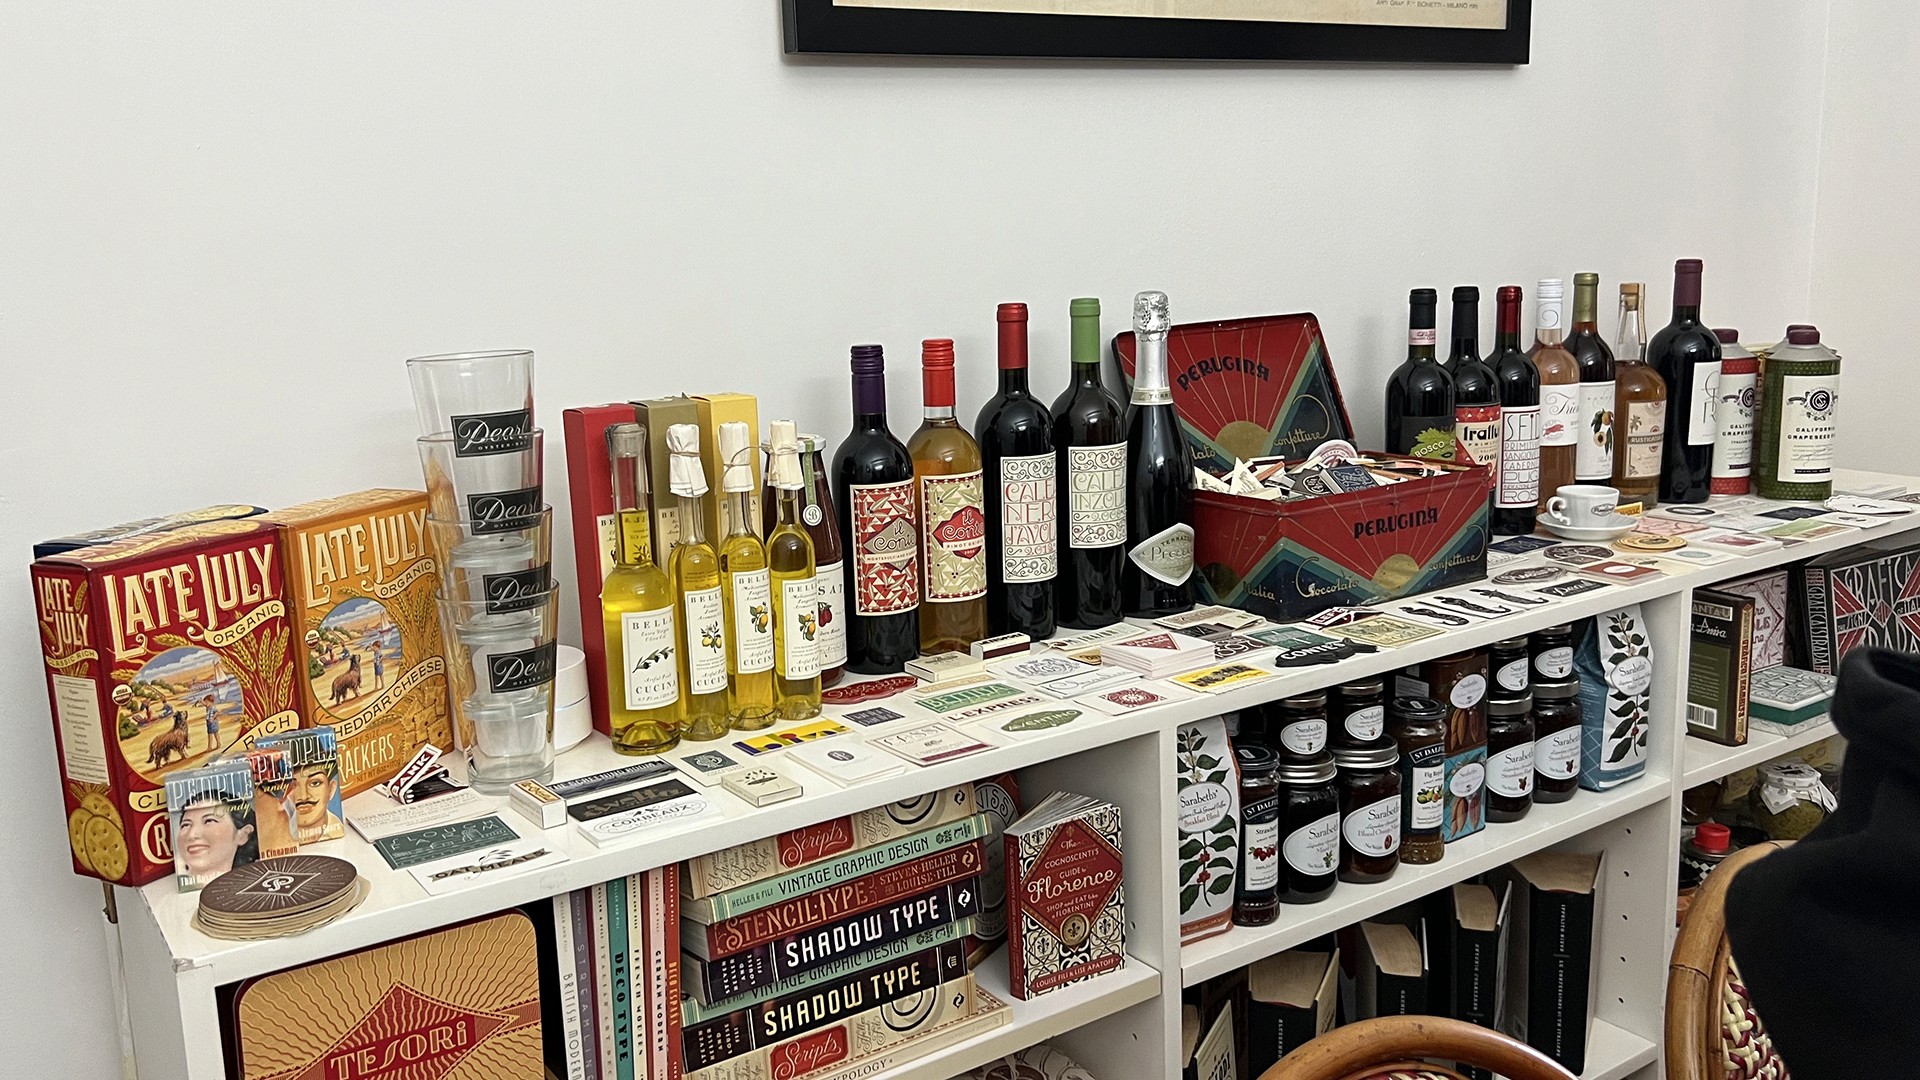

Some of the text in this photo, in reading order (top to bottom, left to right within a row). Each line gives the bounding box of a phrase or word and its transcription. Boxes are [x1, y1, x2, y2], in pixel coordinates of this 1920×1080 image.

[1176, 355, 1270, 392] PERUGINA
[457, 413, 530, 451] Pearl
[1414, 441, 1445, 458] BOSCO
[1353, 505, 1438, 540] PERUGINA
[299, 508, 428, 609] LATE JULY
[380, 561, 432, 596] ORGANIC
[37, 576, 74, 622] LATE
[1844, 555, 1913, 607] GRAFICA
[103, 543, 274, 663] LATE JULY
[212, 602, 281, 645] ORGANIC
[1808, 586, 1827, 627] GRAFICA
[52, 610, 89, 655] JULY
[493, 656, 550, 687] Pear
[334, 660, 442, 737] HEDDAR CHEESE
[948, 694, 1041, 722] L'EXPRESS
[243, 714, 291, 749] RICH
[166, 769, 254, 812] PEOPLE
[391, 753, 431, 798] BANK
[611, 803, 692, 829] CORBEAUX
[777, 836, 930, 895] VINTAGE GRAPHIC DESIGN
[781, 820, 850, 869] Scripts
[1044, 847, 1100, 870] COGNOSCENTI'S
[1060, 839, 1078, 850] The
[1027, 868, 1118, 904] Florence
[1058, 866, 1081, 879] GUIDE
[1046, 900, 1064, 913] SHOP
[1074, 895, 1088, 906] EAT
[1055, 900, 1095, 920] FLORENTINE
[785, 895, 940, 968] SHADOW TYPE
[751, 938, 910, 999] VINTAGE GRAPHIC DESIGN
[1035, 972, 1058, 989] LOUISE
[1058, 970, 1069, 982] FILI
[1074, 965, 1087, 977] LISE
[1087, 956, 1115, 974] APATOFF
[563, 972, 577, 1024] BRITISH
[577, 943, 595, 1080] STREAMLINE
[614, 951, 629, 1062] DECO TYPE
[655, 949, 665, 1053] GERMAN MODERN
[763, 961, 921, 1037] SHADOW TYPE
[774, 1032, 842, 1080] Scripts
